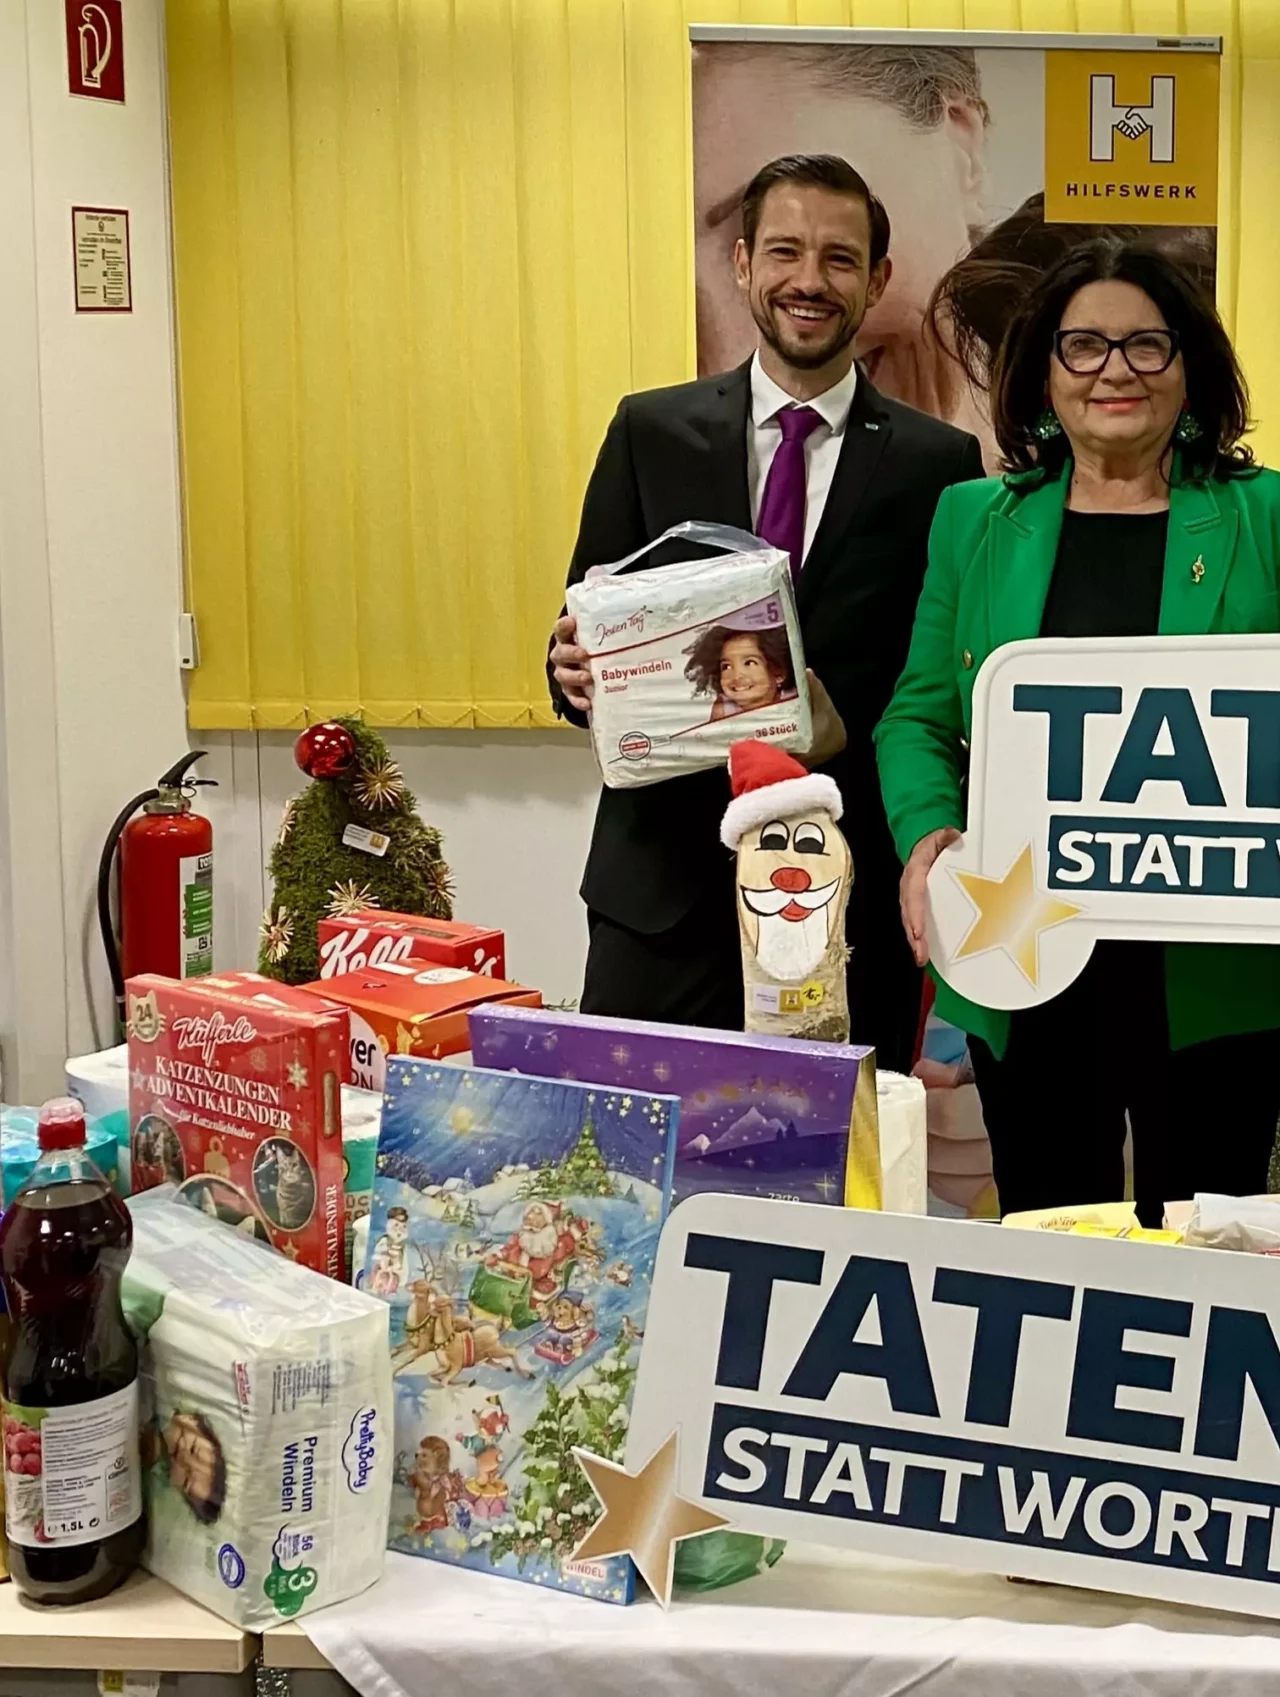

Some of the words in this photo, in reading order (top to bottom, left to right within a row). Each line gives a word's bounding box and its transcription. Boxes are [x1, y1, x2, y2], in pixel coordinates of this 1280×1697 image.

[1066, 183, 1197, 199] HILFSWERK
[767, 602, 779, 622] 5
[601, 661, 672, 681] Babywindeln
[1056, 831, 1266, 889] STATT
[136, 1004, 153, 1021] 24
[156, 1056, 281, 1105] KATZENZUNGEN
[147, 1076, 293, 1131] ADVENTKALENDER
[281, 1442, 299, 1513] Windeln
[301, 1436, 318, 1512] Premium
[714, 1428, 985, 1525] STATT
[302, 1535, 313, 1551] 56
[288, 1571, 315, 1592] 3
